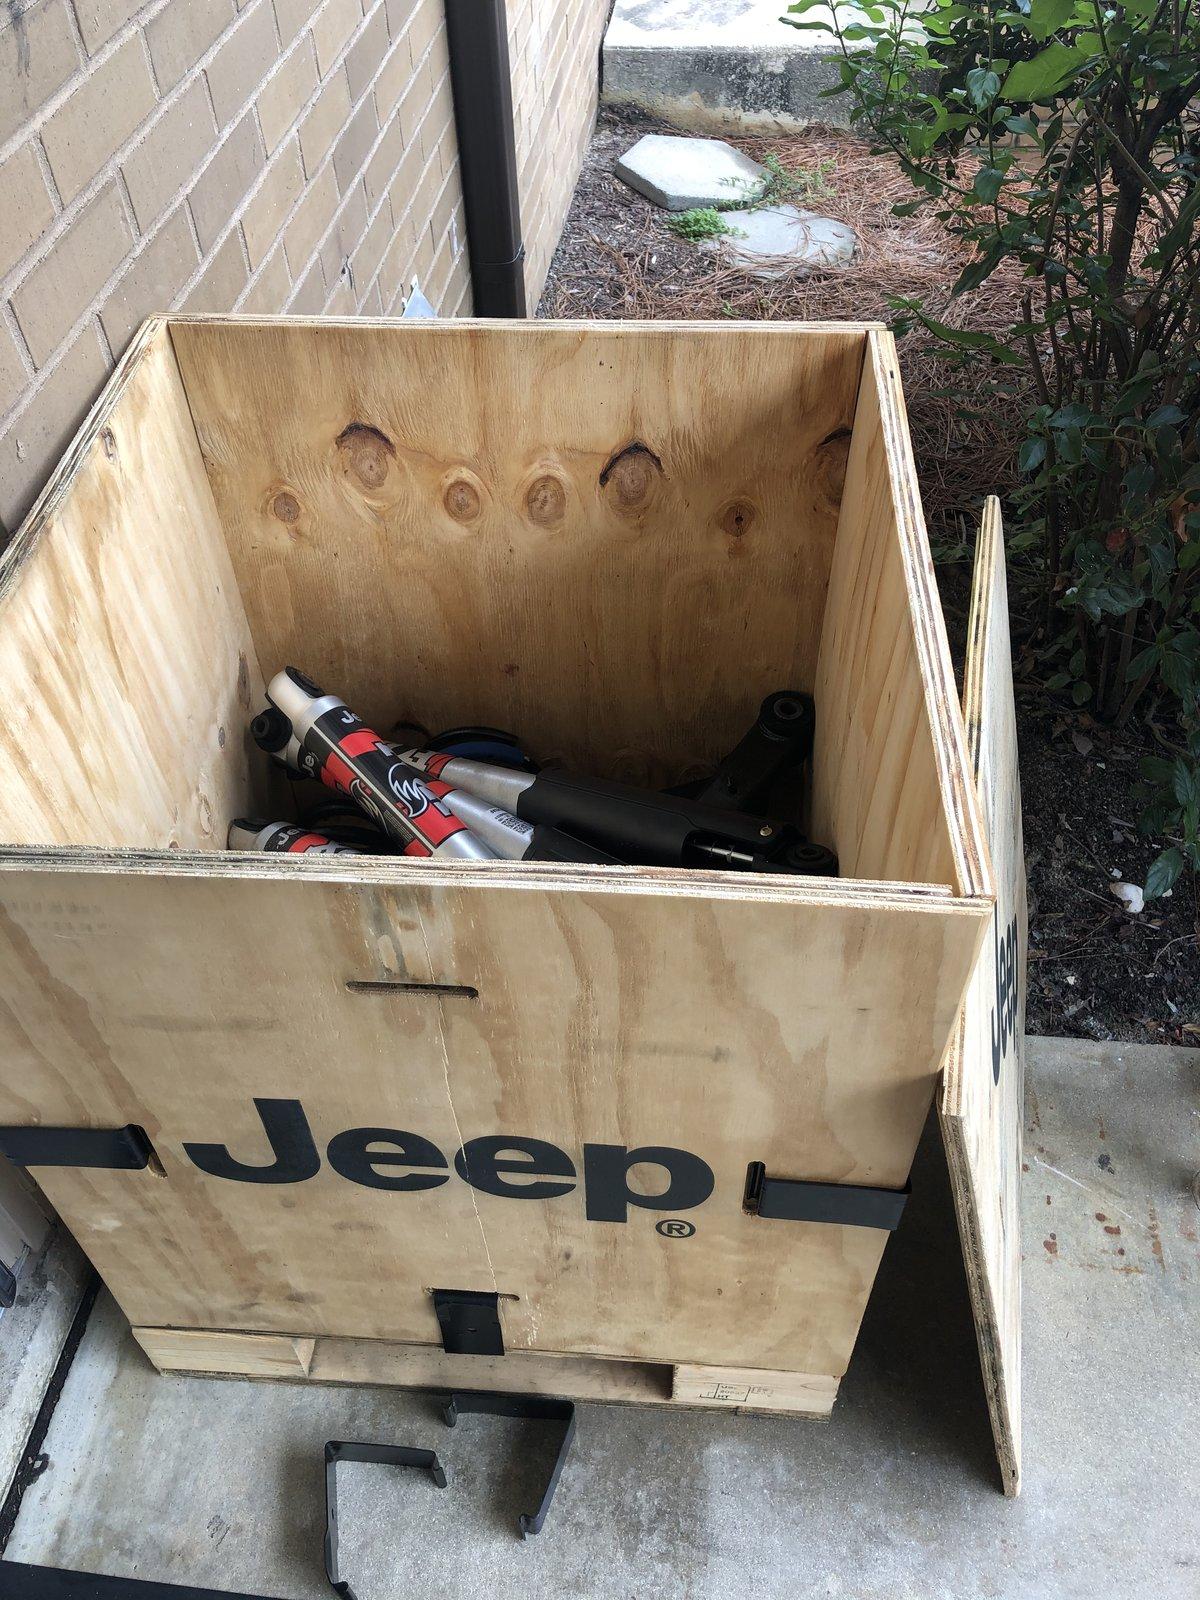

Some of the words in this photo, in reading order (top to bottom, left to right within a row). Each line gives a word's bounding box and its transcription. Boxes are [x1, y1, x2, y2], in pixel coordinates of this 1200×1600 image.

[341, 710, 362, 724] Je
[277, 829, 299, 846] Je
[991, 900, 1017, 1086] Jeep
[182, 1097, 715, 1223] Jeep
